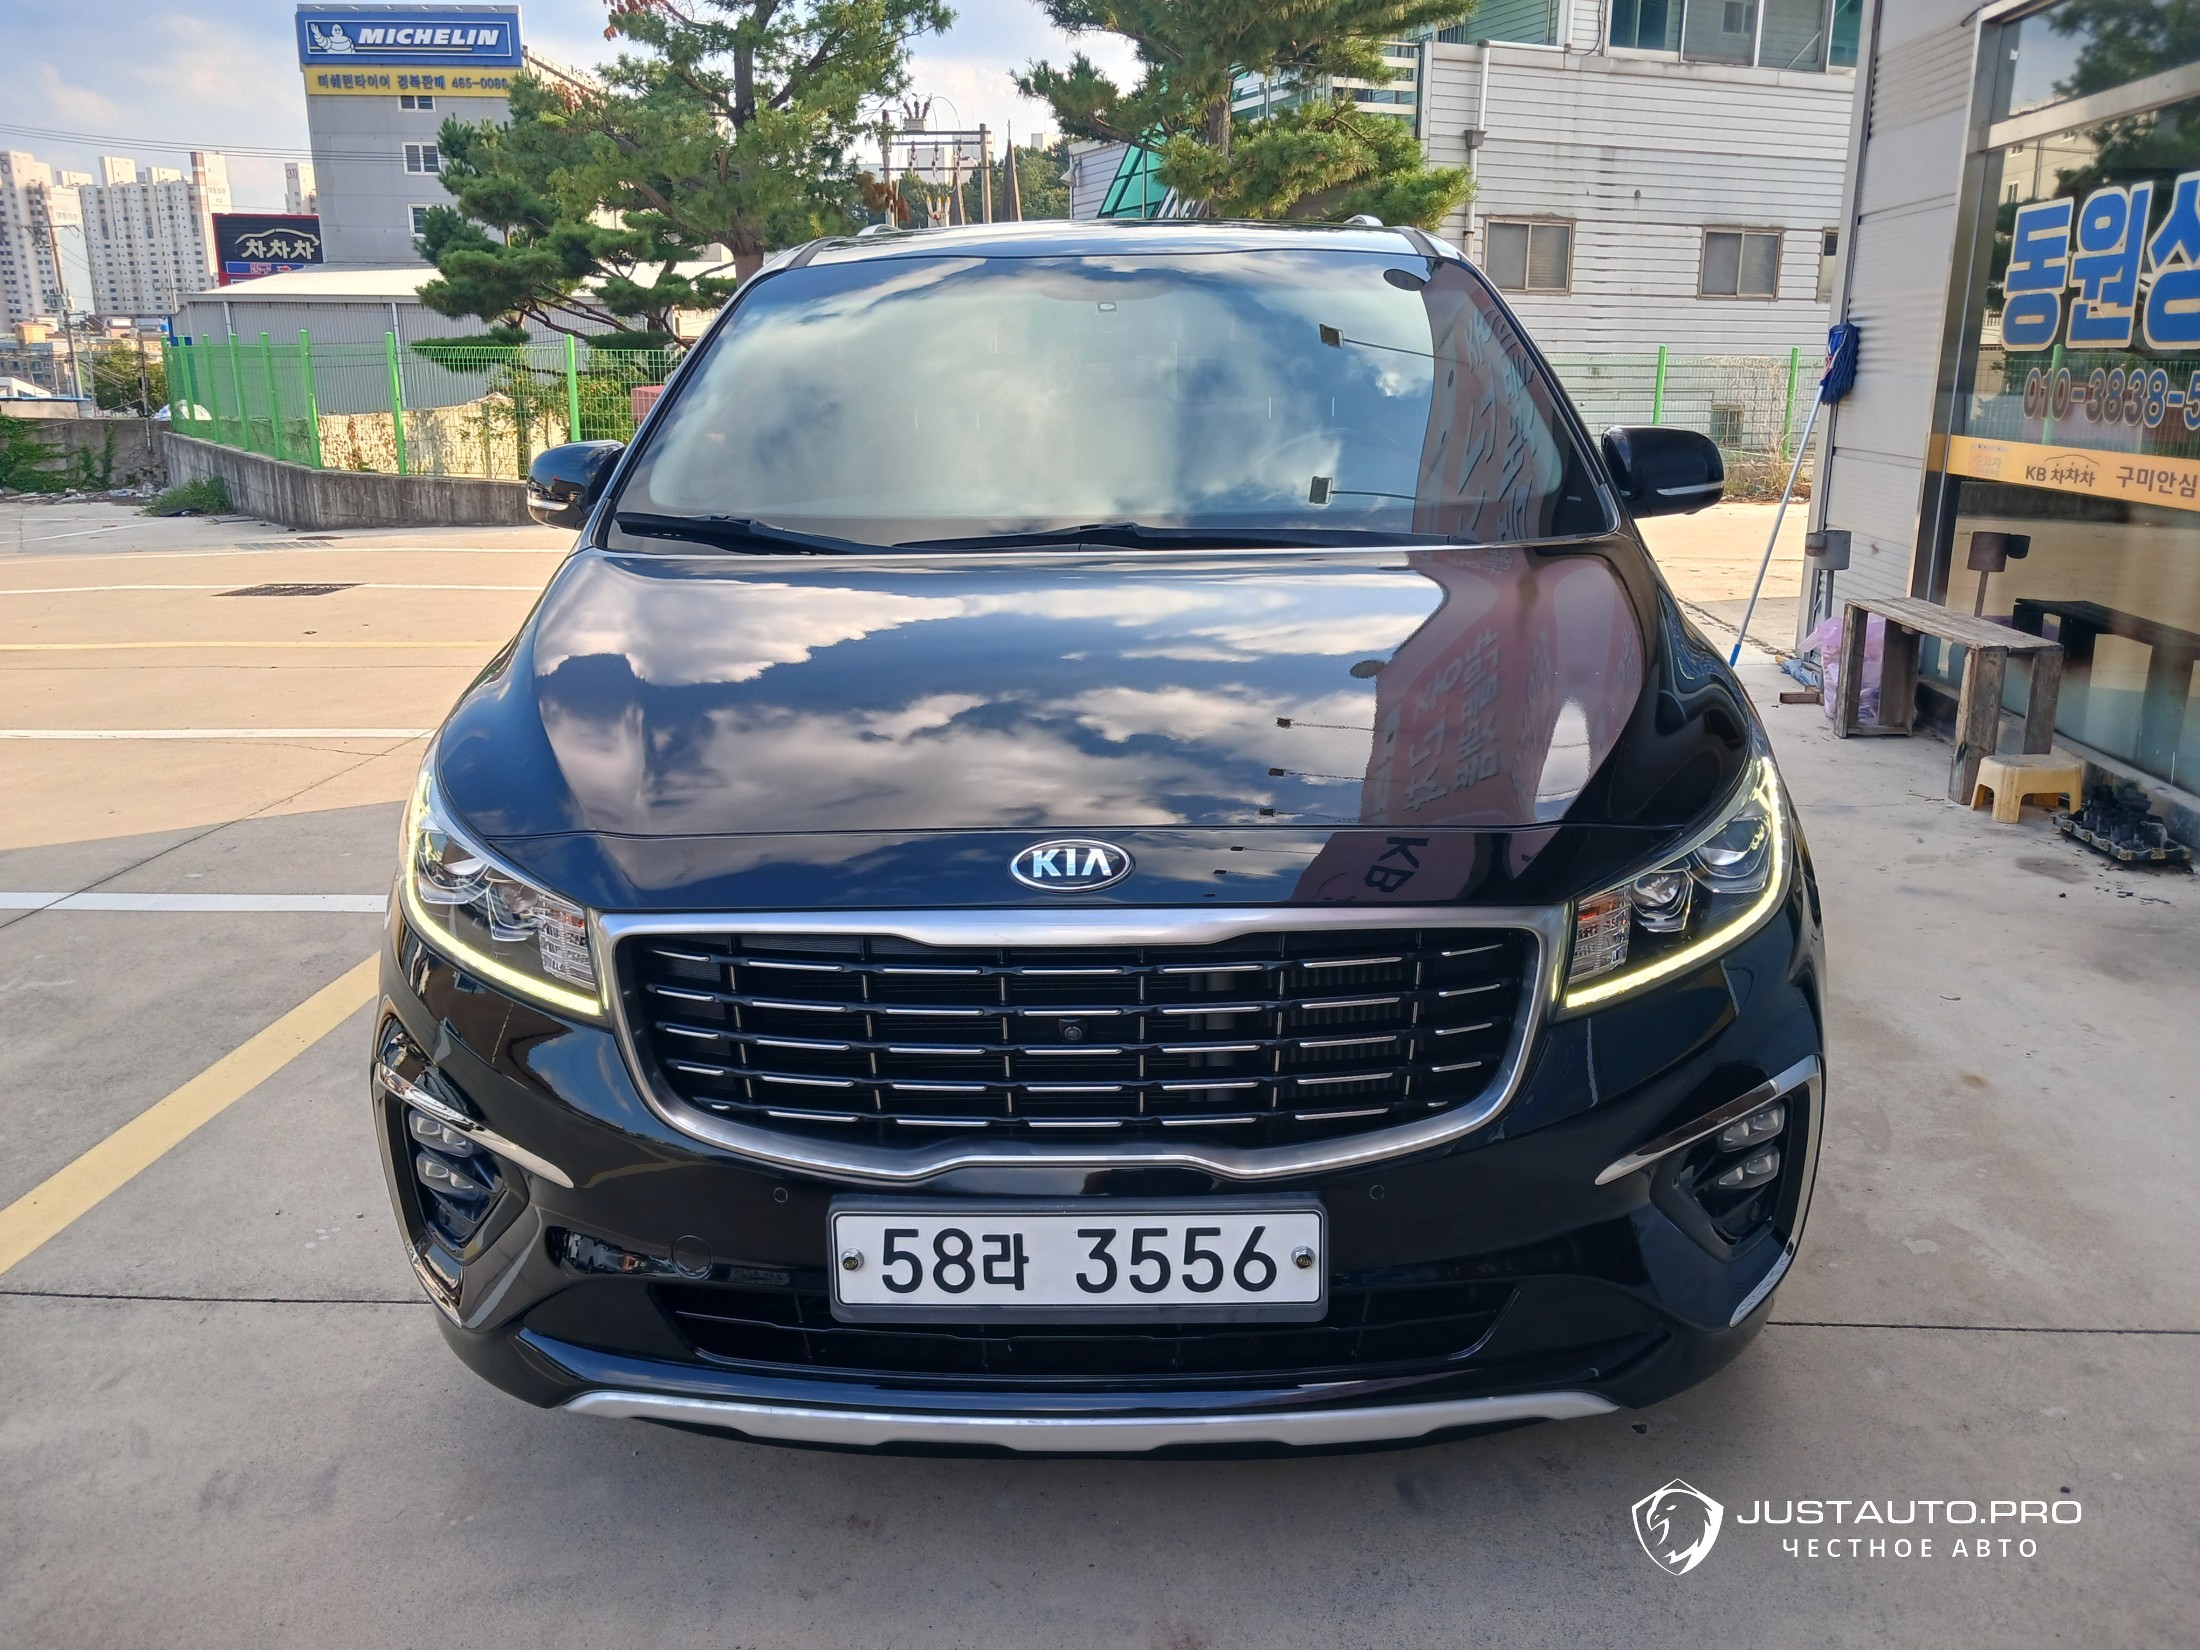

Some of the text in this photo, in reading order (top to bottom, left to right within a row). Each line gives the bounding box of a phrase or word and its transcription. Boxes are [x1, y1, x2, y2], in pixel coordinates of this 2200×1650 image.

[358, 28, 499, 46] MICHELIN
[317, 73, 390, 89] 미쉐린타이어
[397, 74, 446, 90] 경북판매
[241, 238, 315, 260] 차차차
[2025, 466, 2047, 482] KB
[2050, 461, 2097, 488] 차차차
[2116, 466, 2199, 499] 구미안심
[1032, 848, 1112, 878] KIA
[881, 1226, 1277, 1294] 58라 3556
